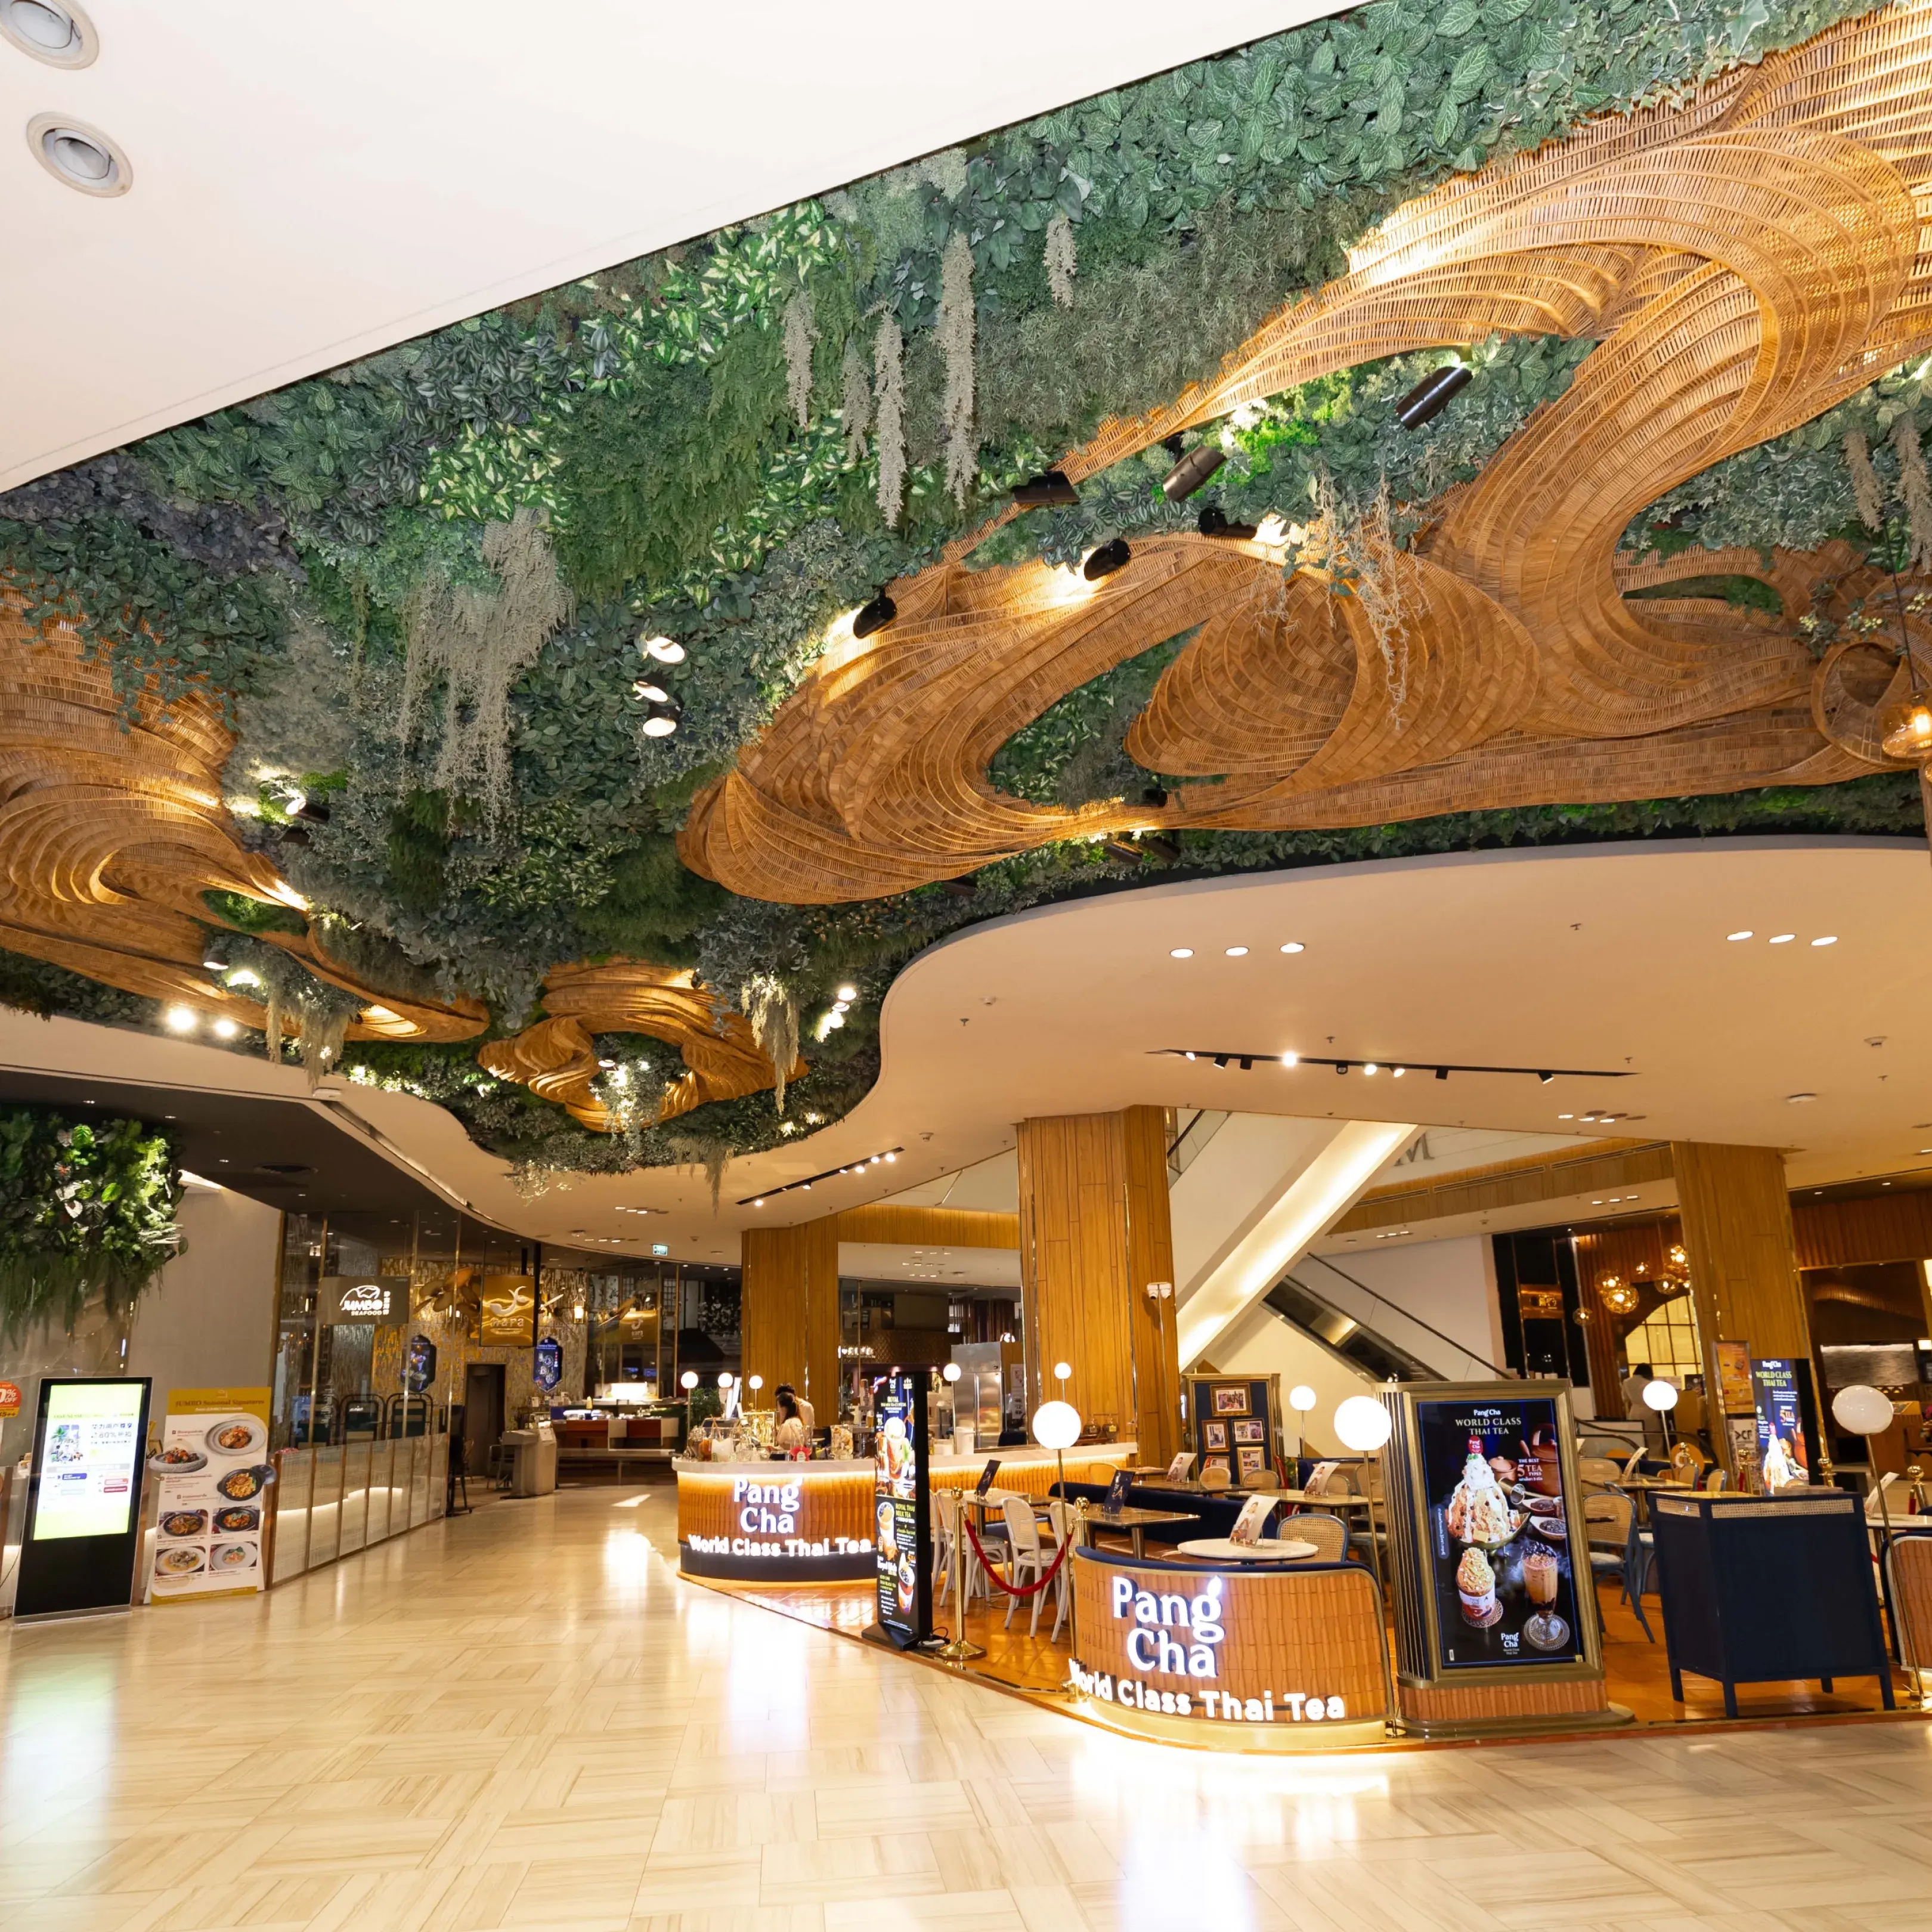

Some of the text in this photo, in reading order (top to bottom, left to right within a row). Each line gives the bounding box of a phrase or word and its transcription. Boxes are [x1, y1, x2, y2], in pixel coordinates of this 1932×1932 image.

[490, 1318, 525, 1327] nara
[1456, 1417, 1521, 1427] WORLD CLASS
[1517, 1465, 1525, 1477] 5
[734, 1476, 803, 1512] Pang
[741, 1507, 794, 1533] Cha
[688, 1534, 872, 1557] World Class Thai Tea
[1113, 1575, 1225, 1643] Pang
[1500, 1632, 1519, 1642] Pang
[1127, 1627, 1218, 1678] Cha
[1069, 1658, 1346, 1722] World Class Thai Tea
